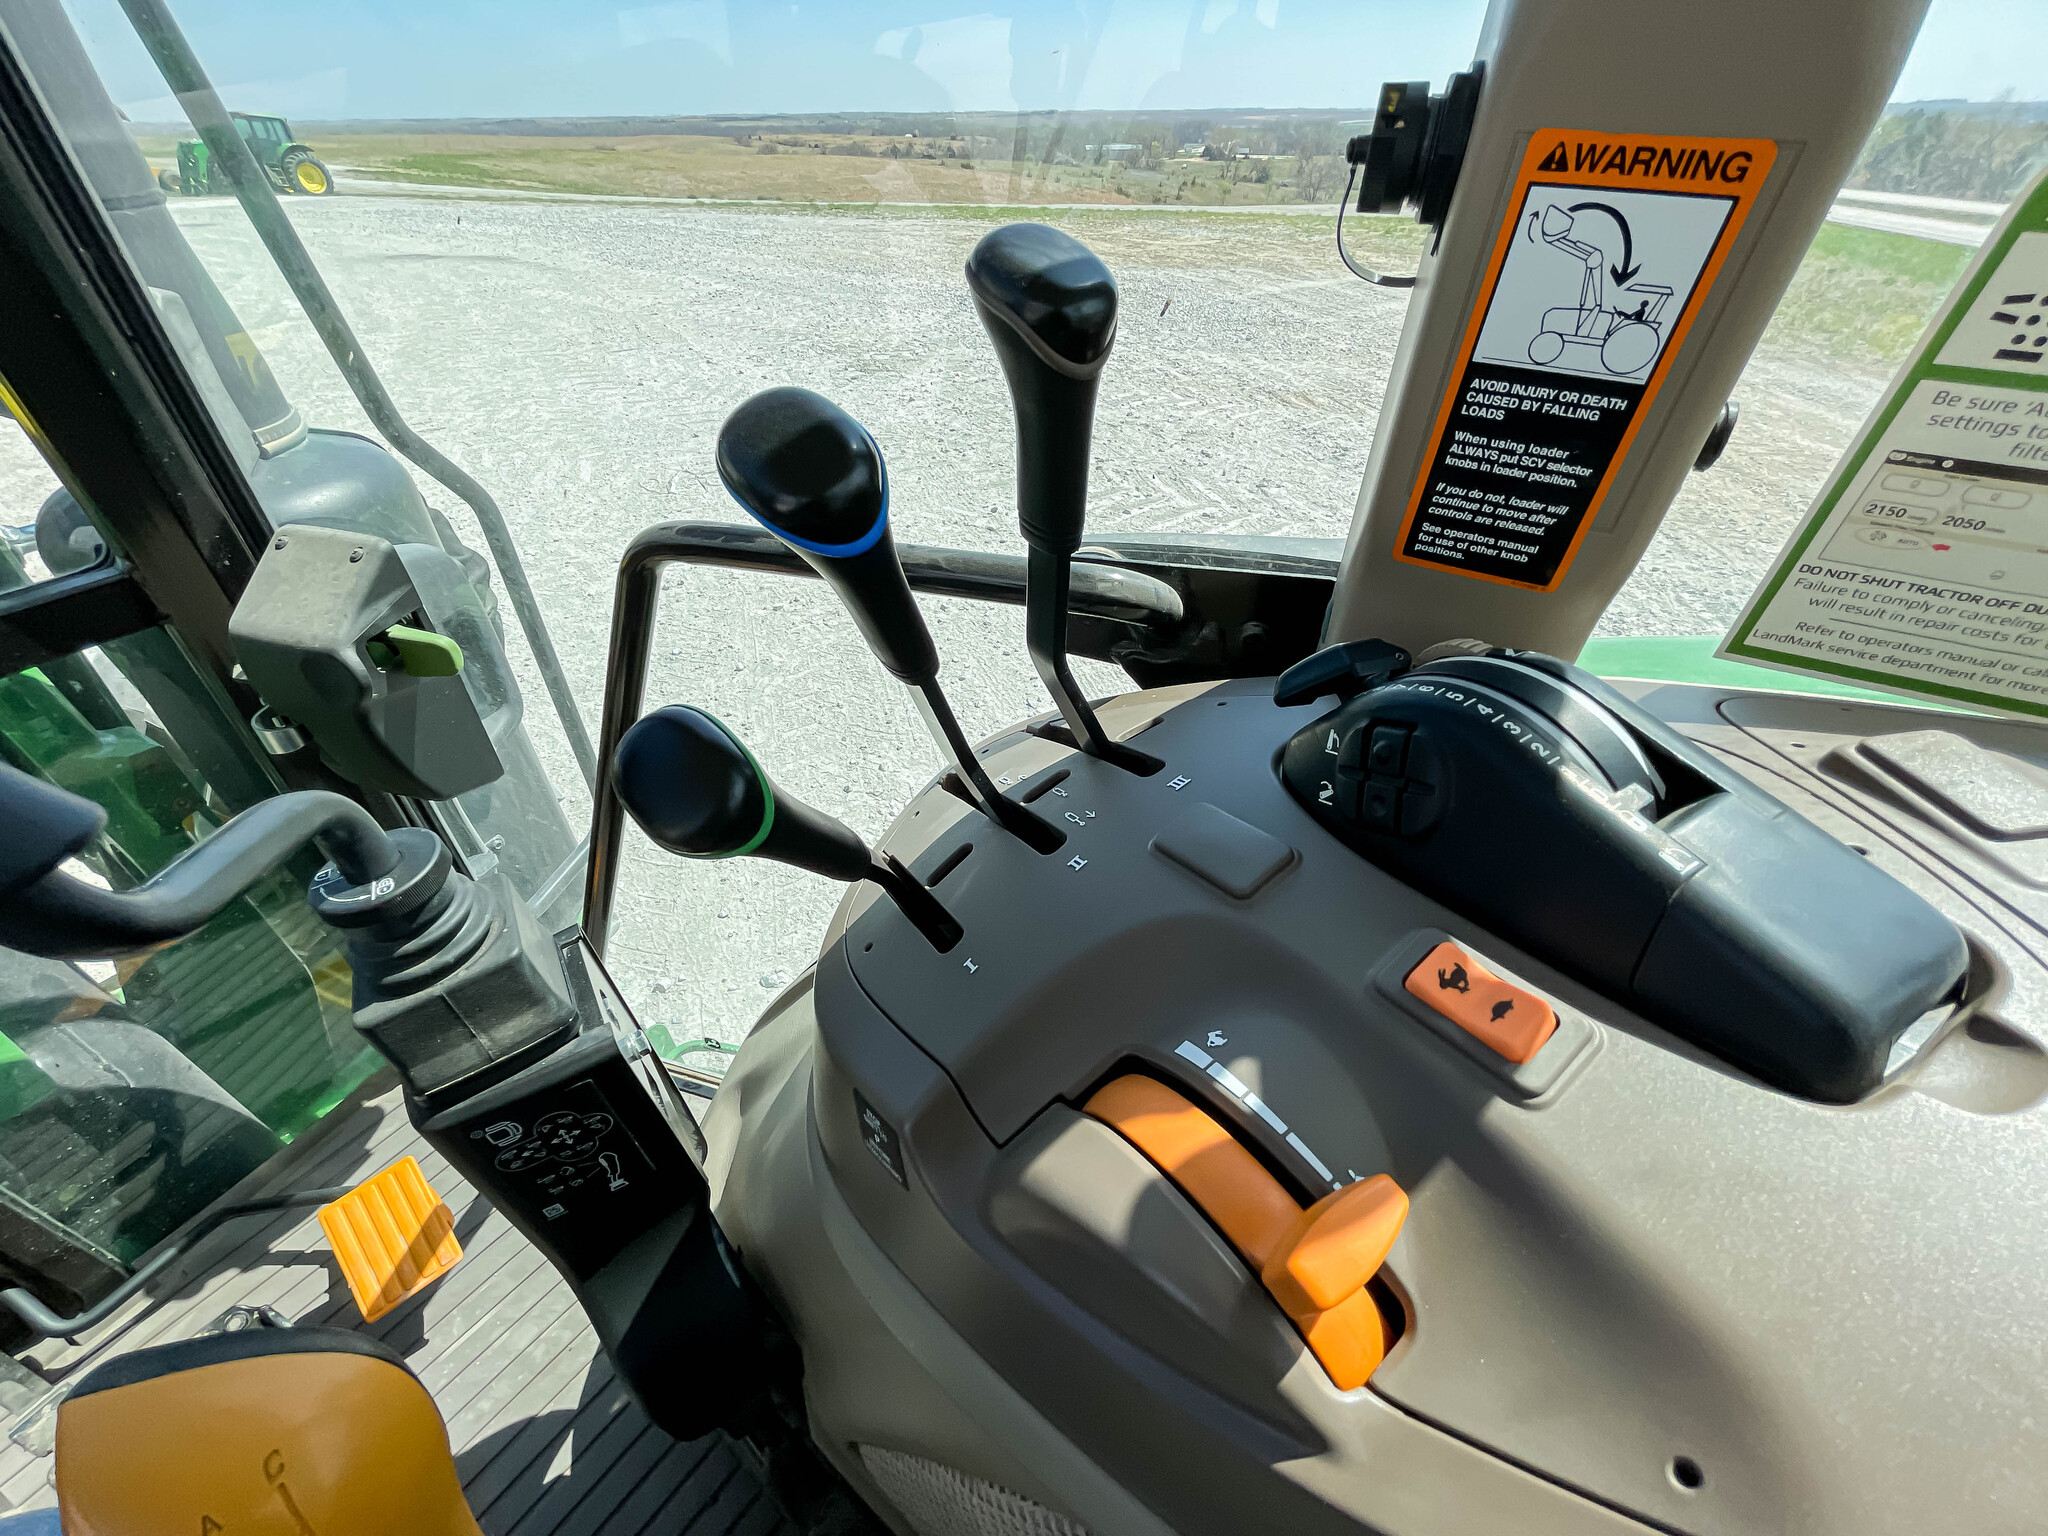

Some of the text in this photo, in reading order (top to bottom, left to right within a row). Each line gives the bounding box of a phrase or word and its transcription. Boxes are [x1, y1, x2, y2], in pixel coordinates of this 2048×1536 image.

[1575, 143, 1753, 184] WARNING
[1466, 391, 1600, 421] CAUSED BY FALLING
[1470, 378, 1628, 411] AVOID INJURY OR DEATH
[1931, 390, 1962, 407] Be
[1965, 396, 2018, 414] sure
[1461, 404, 1505, 420] LOADS
[1926, 414, 2023, 438] settings
[1449, 443, 1593, 477] ALWAYS put SCV selector
[1454, 430, 1570, 459] When using loader
[1445, 455, 1577, 488] knobs in loader position.
[1432, 495, 1557, 525] continue to move after
[1435, 482, 1570, 515] If you do not, loader will
[1865, 503, 1908, 519] 2150
[1428, 506, 1545, 536] controls are released.
[1941, 515, 1987, 531] 2050
[1414, 543, 1465, 560] positions.
[1418, 532, 1529, 563] for use of other knob
[1421, 522, 1539, 554] See operators manual
[1794, 577, 1848, 596] Failure
[1852, 588, 1869, 600] to
[1873, 595, 1935, 614] comply
[1936, 605, 1957, 615] or
[1798, 564, 1823, 575] DO
[1824, 568, 1860, 582] NOT
[1859, 575, 1906, 590] SHUT
[1907, 582, 1984, 605] TRACTOR
[1985, 598, 2022, 610] OFF
[1809, 598, 1838, 609] will
[1839, 602, 1887, 619] result
[1889, 611, 1905, 622] in
[1907, 616, 1960, 631] repair
[1961, 626, 2010, 641] costs
[2014, 633, 2043, 646] for
[1752, 628, 1826, 650] LandMark
[1826, 645, 1879, 661] service
[1881, 655, 1976, 680] department
[1980, 673, 2006, 685] for
[1795, 622, 1837, 637] Refer
[1838, 630, 1855, 640] to
[1857, 635, 1933, 655] operators
[1936, 650, 2002, 668] manual
[2001, 663, 2021, 671] or
[1445, 691, 1465, 701] 5
[1477, 703, 1494, 715] 4
[1503, 721, 1522, 735] 3
[1530, 742, 1551, 757] 2
